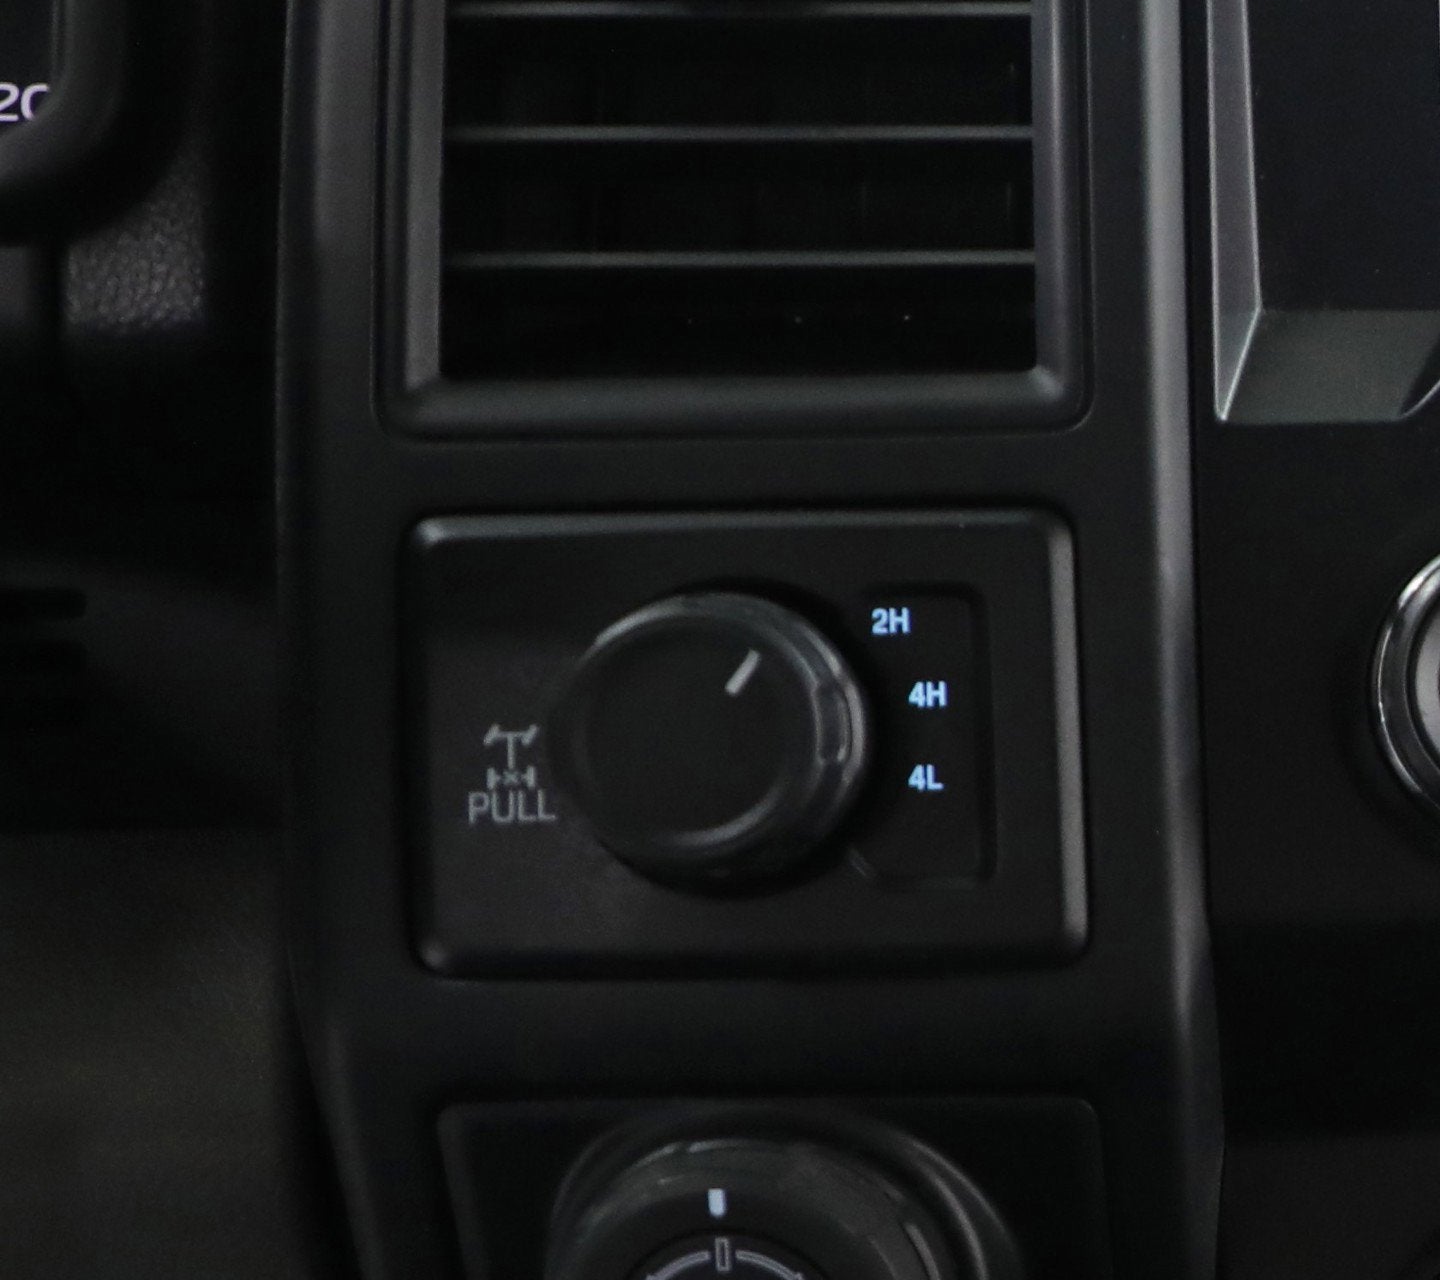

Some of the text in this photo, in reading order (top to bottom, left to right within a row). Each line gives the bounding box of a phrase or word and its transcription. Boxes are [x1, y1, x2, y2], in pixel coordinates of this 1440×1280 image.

[871, 607, 911, 636] 2H
[908, 680, 948, 708] 4H
[908, 764, 944, 791] 4L
[468, 789, 557, 824] PULL
